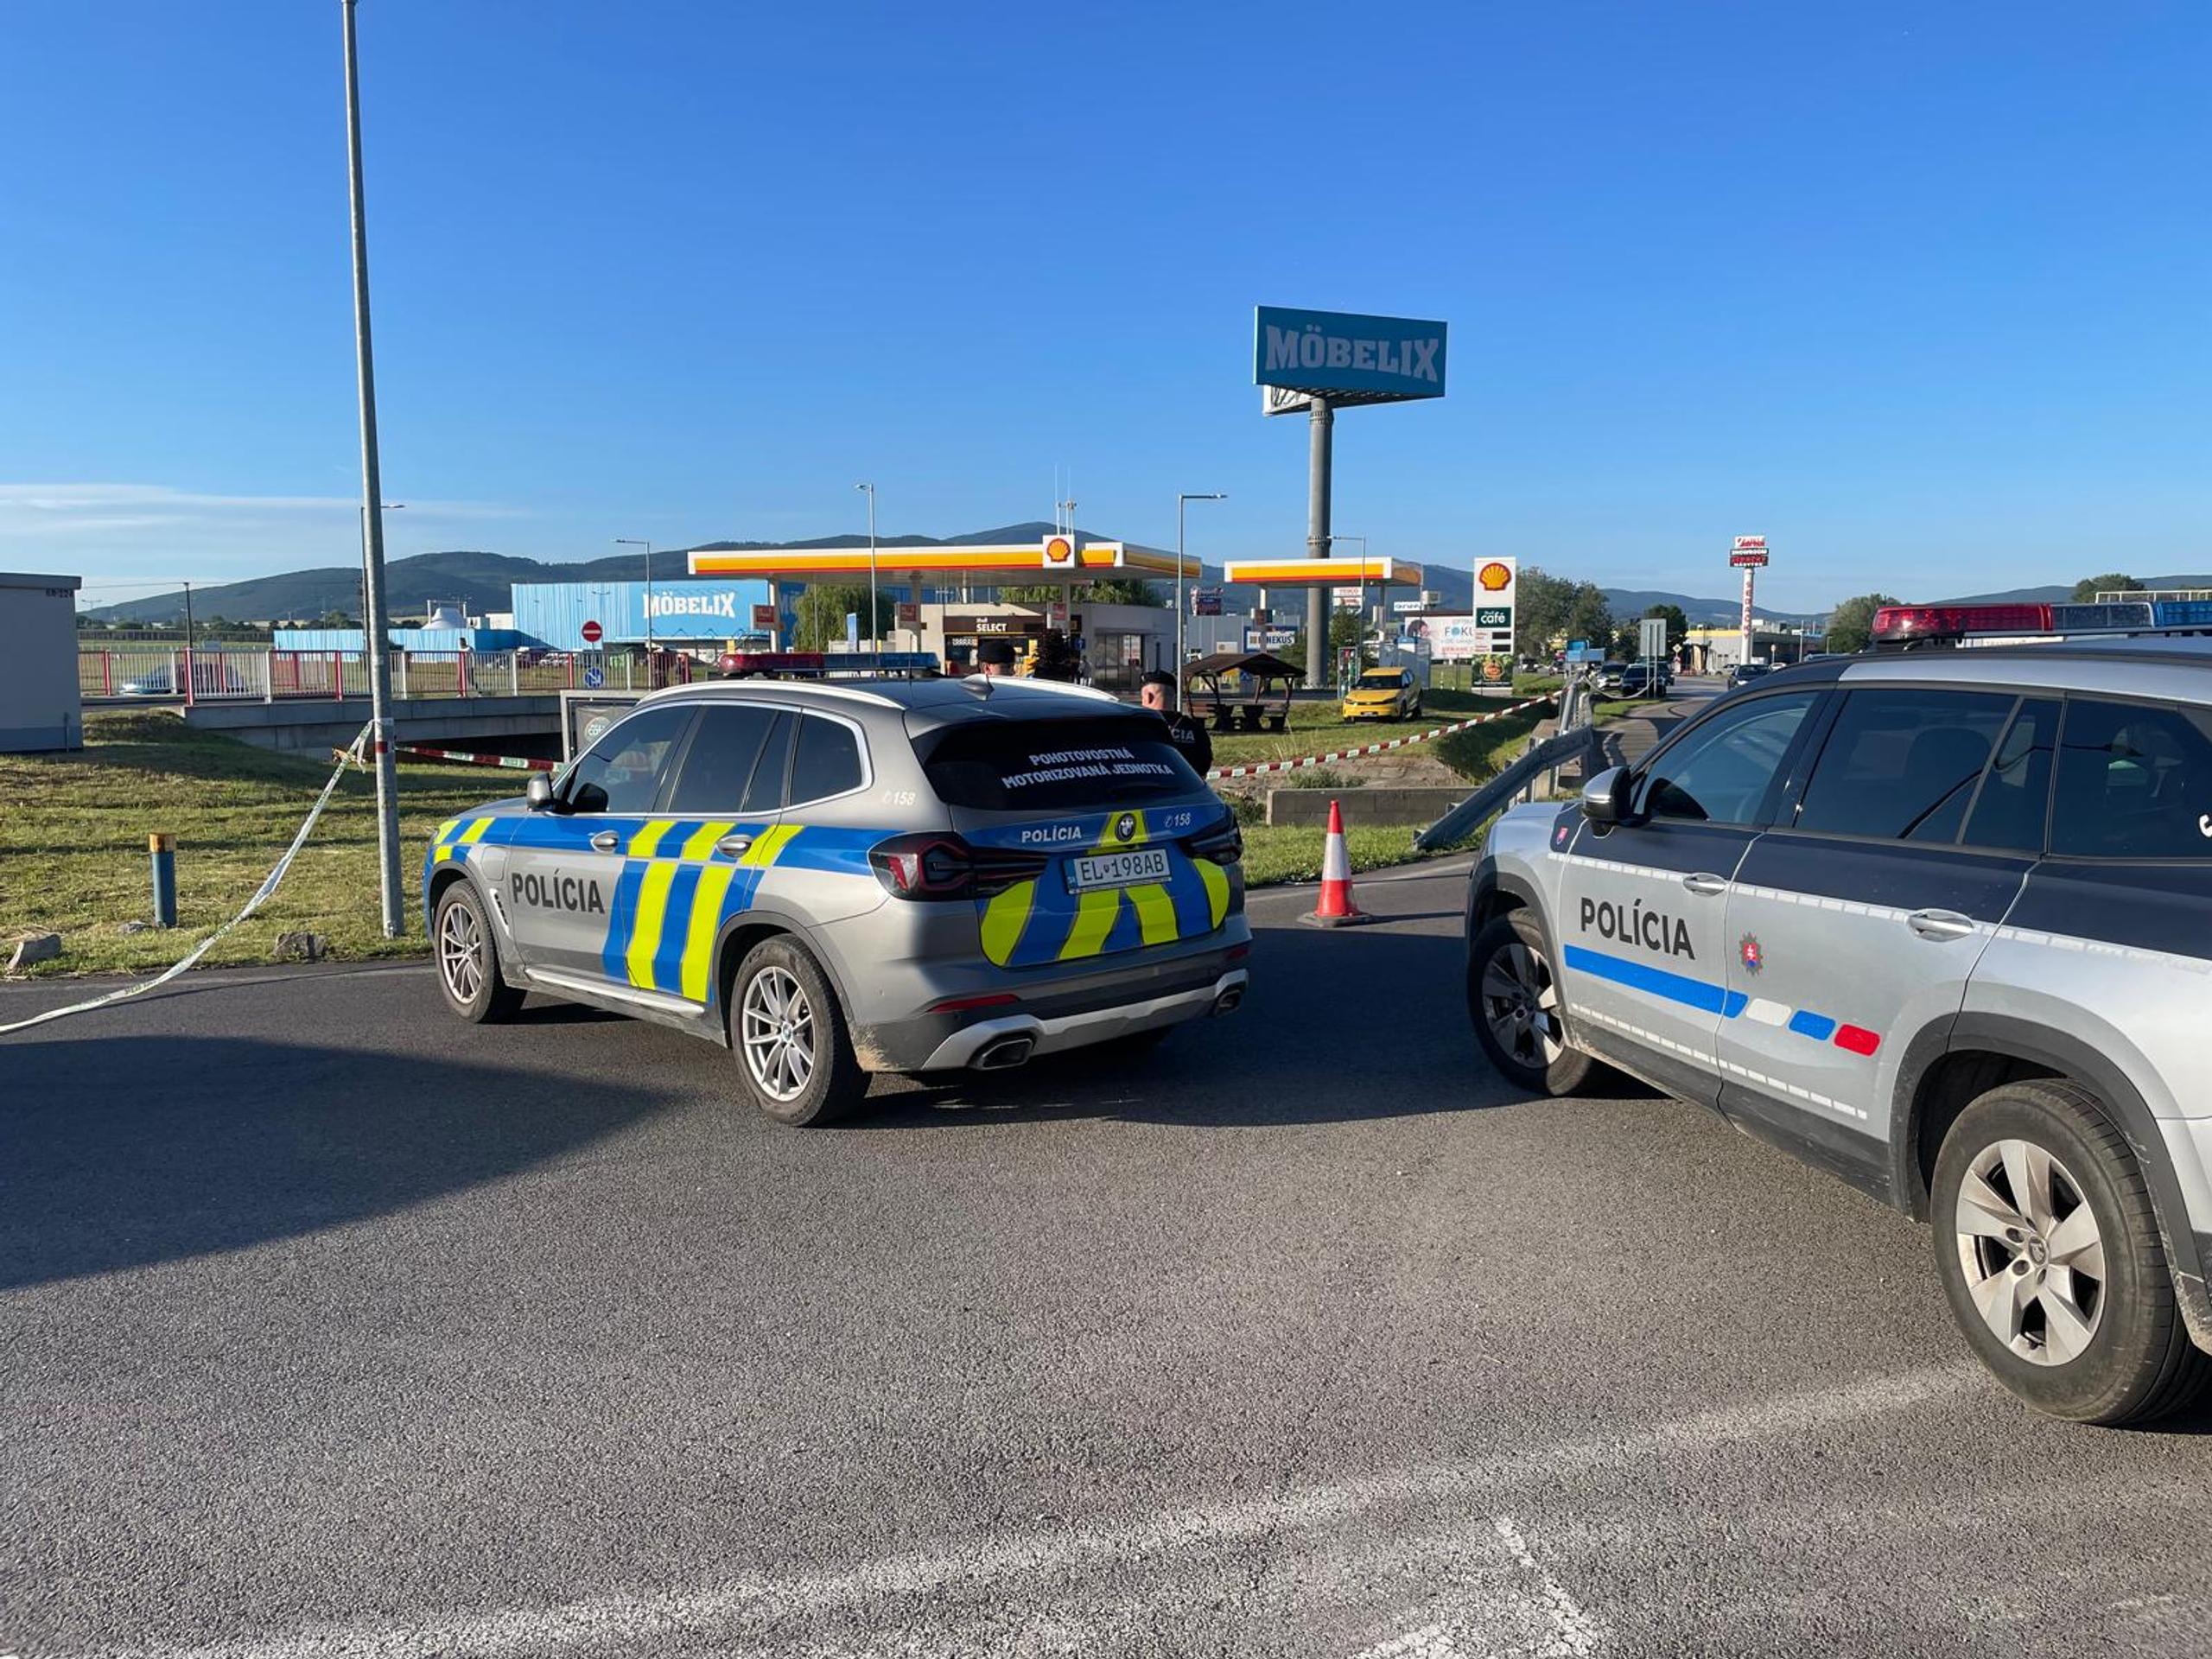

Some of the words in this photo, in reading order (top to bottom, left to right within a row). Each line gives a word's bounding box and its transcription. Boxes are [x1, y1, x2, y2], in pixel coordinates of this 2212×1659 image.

[1265, 324, 1439, 383] MÖBELIX
[643, 591, 735, 619] MÖBELIX
[976, 623, 1007, 632] SELECT
[1480, 612, 1505, 624] café
[1029, 747, 1134, 766] POHOTOVOSTNÁ
[1001, 762, 1111, 789] MOTORIZOVANÁ
[1112, 764, 1174, 775] JEDNOTKA
[893, 791, 916, 805] 158
[1173, 812, 1192, 826] 158
[1022, 826, 1081, 842] POLÍCIA
[512, 868, 605, 913] POLÍCIA
[1581, 898, 1696, 960] POLÍCIA
